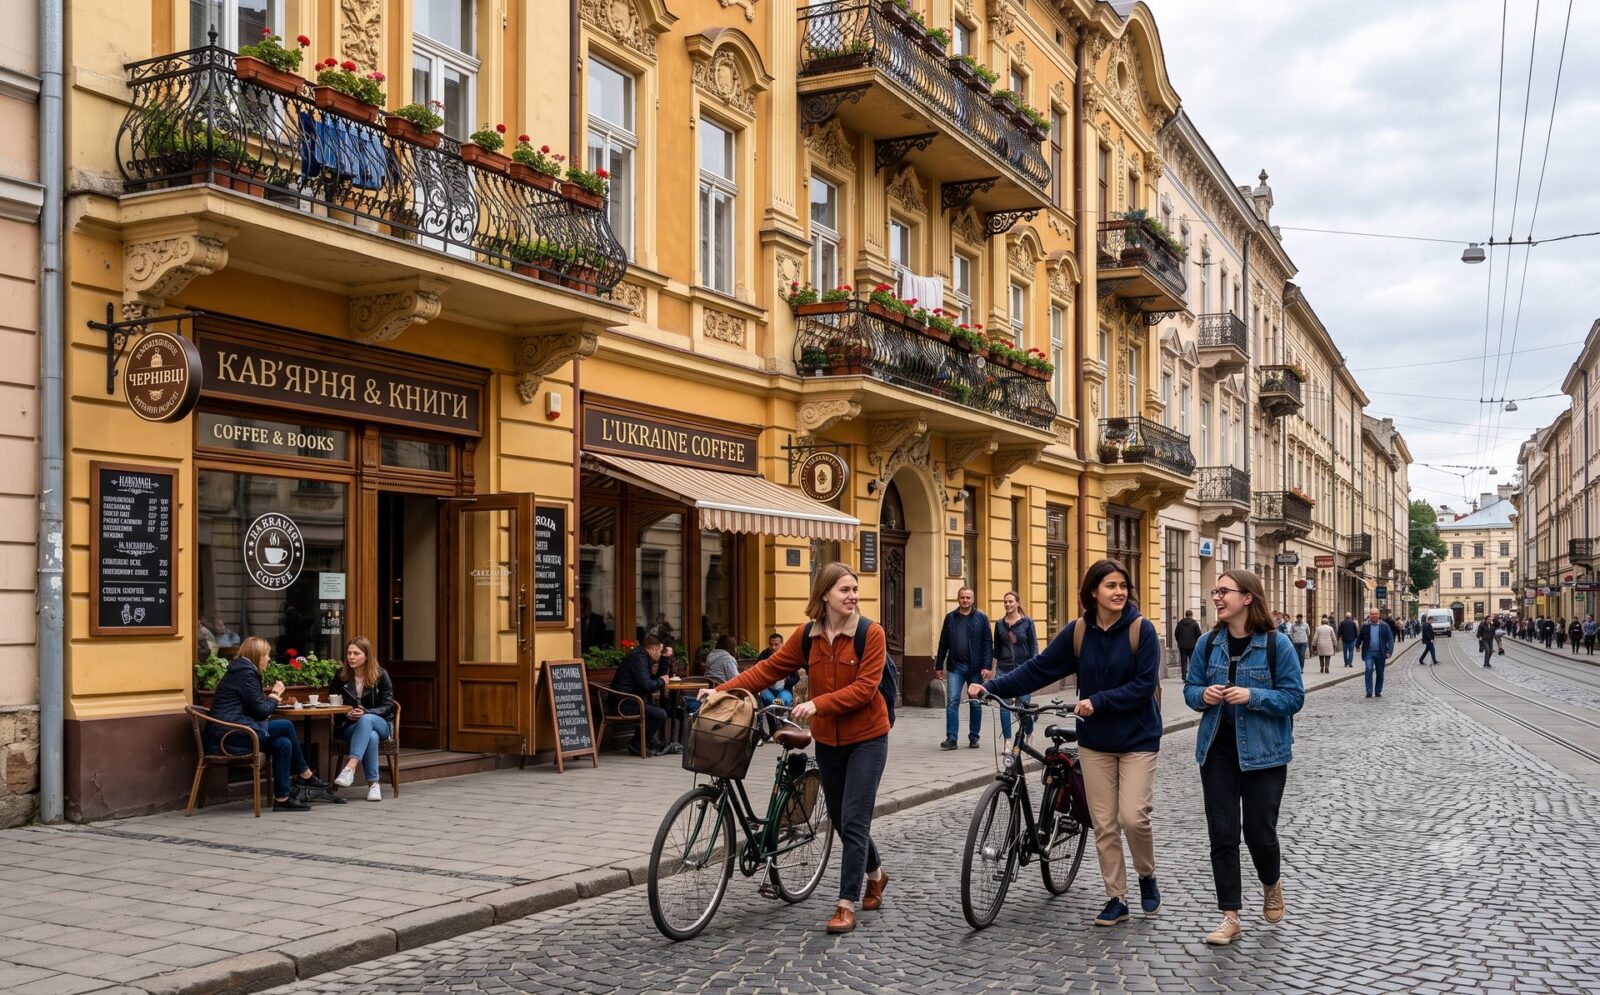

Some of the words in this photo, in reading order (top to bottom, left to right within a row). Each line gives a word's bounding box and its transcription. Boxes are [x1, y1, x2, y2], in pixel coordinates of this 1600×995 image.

[128, 368, 185, 387] ЧЕРНІВЦІ
[363, 378, 383, 406] &
[388, 381, 468, 420] КНИГИ
[213, 423, 269, 444] COFFEE
[272, 430, 284, 446] &
[287, 432, 334, 452] BOOKS
[602, 418, 688, 454] L'UKRAINE
[691, 435, 745, 463] COFFEE
[255, 570, 293, 587] COFFEE
